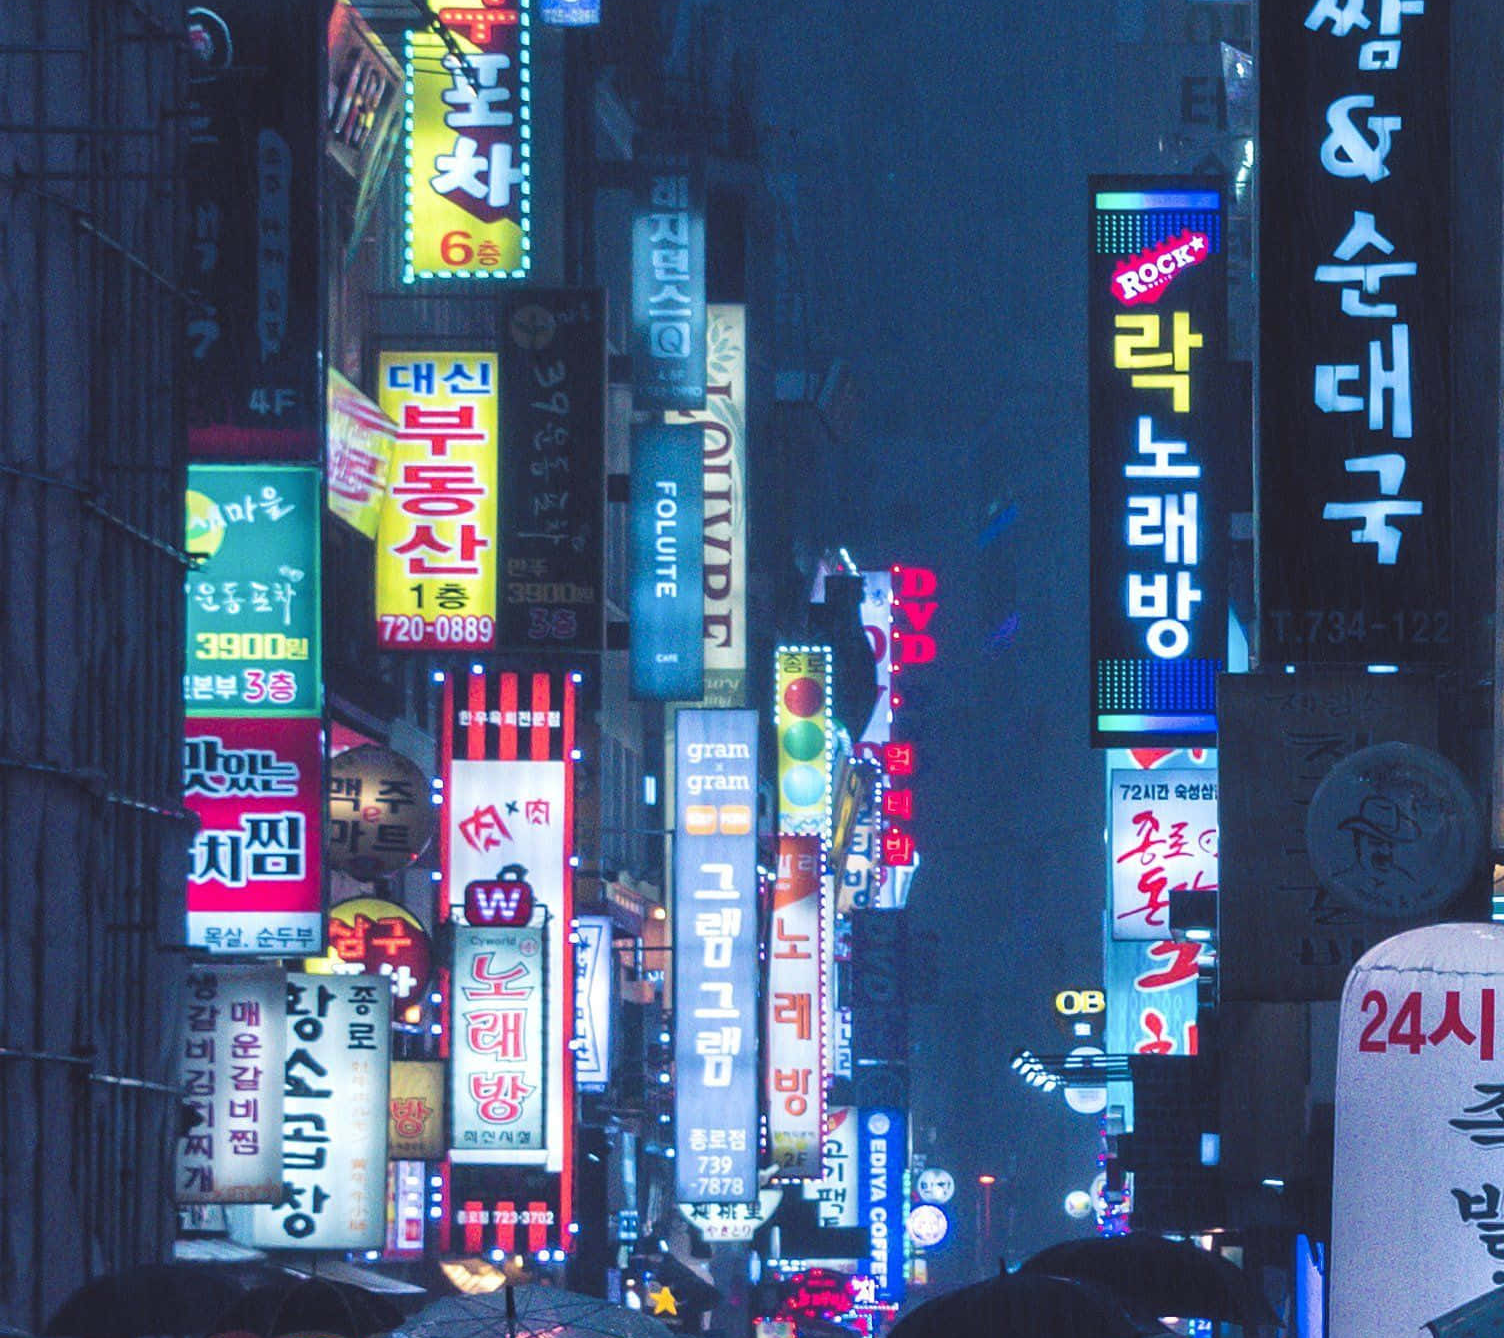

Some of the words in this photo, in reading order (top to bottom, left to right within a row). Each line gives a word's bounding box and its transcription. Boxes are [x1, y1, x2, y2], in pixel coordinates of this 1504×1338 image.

[439, 230, 502, 267] 6층
[1116, 244, 1192, 302] ROCK
[388, 362, 493, 395] 대신
[391, 403, 490, 577] 부동산
[408, 583, 472, 611] 1층
[380, 614, 494, 645] 720-0889
[899, 567, 940, 665] DVD
[195, 632, 310, 661] 3900원
[243, 670, 298, 703] 3층
[687, 742, 751, 763] gram
[687, 773, 751, 796] gram
[1119, 783, 1169, 801] 72시간
[188, 812, 306, 887] 치찜
[474, 886, 522, 921] W
[256, 927, 316, 949] 순두부
[470, 934, 517, 949] Cyworld
[693, 863, 743, 1087] 그램그램
[346, 984, 379, 1051] 종로
[773, 917, 813, 1117] 노래방
[1055, 990, 1106, 1015] OB
[461, 951, 537, 1125] 노래방
[1358, 989, 1496, 1063] 24시
[228, 999, 263, 1157] 매운갈비찜
[687, 1127, 747, 1152] 종로점
[697, 1156, 733, 1174] 739
[869, 1138, 888, 1203] EDIYA
[493, 1210, 555, 1225] 723-3702
